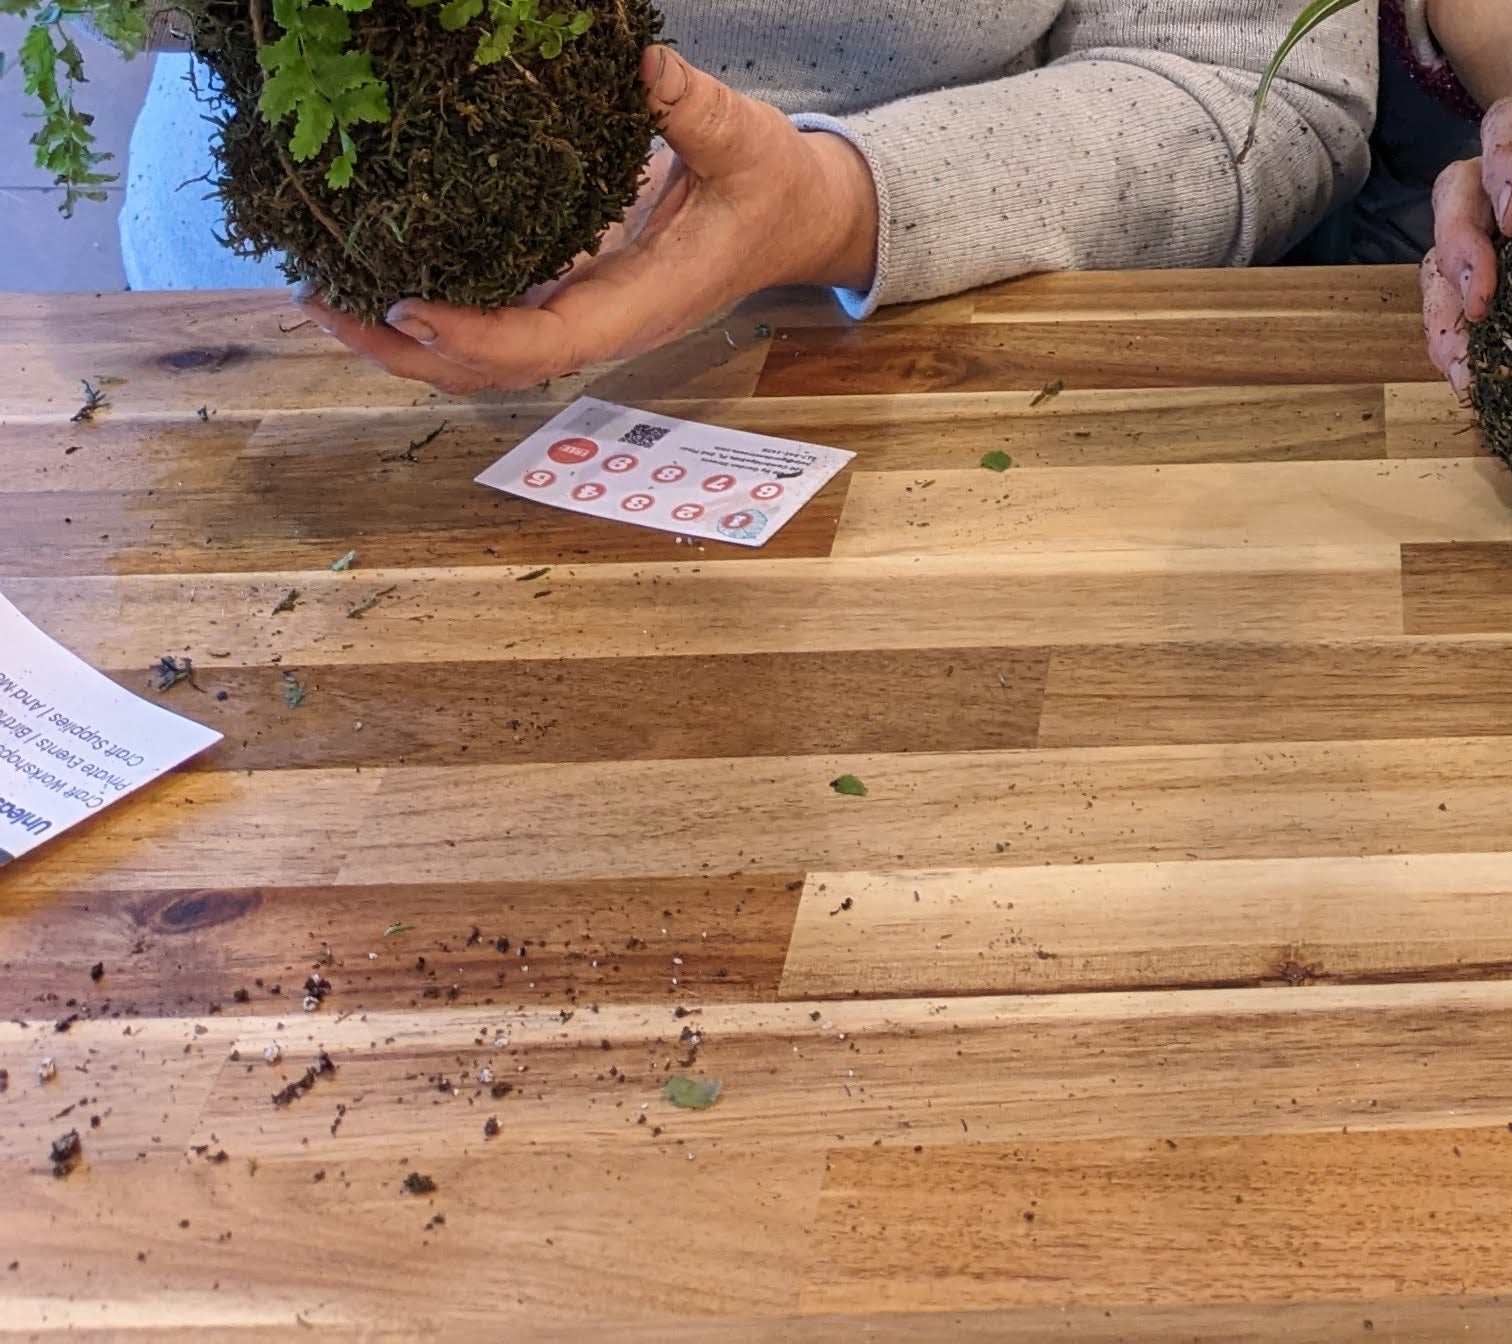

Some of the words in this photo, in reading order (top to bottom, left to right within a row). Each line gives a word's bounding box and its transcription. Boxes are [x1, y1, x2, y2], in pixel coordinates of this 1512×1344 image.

[527, 471, 552, 486] 5
[9, 689, 47, 712] And
[48, 712, 109, 751] Supplies
[36, 738, 85, 769] Events
[104, 744, 144, 767] Craft
[81, 763, 133, 791] Private
[63, 785, 104, 809] Craft
